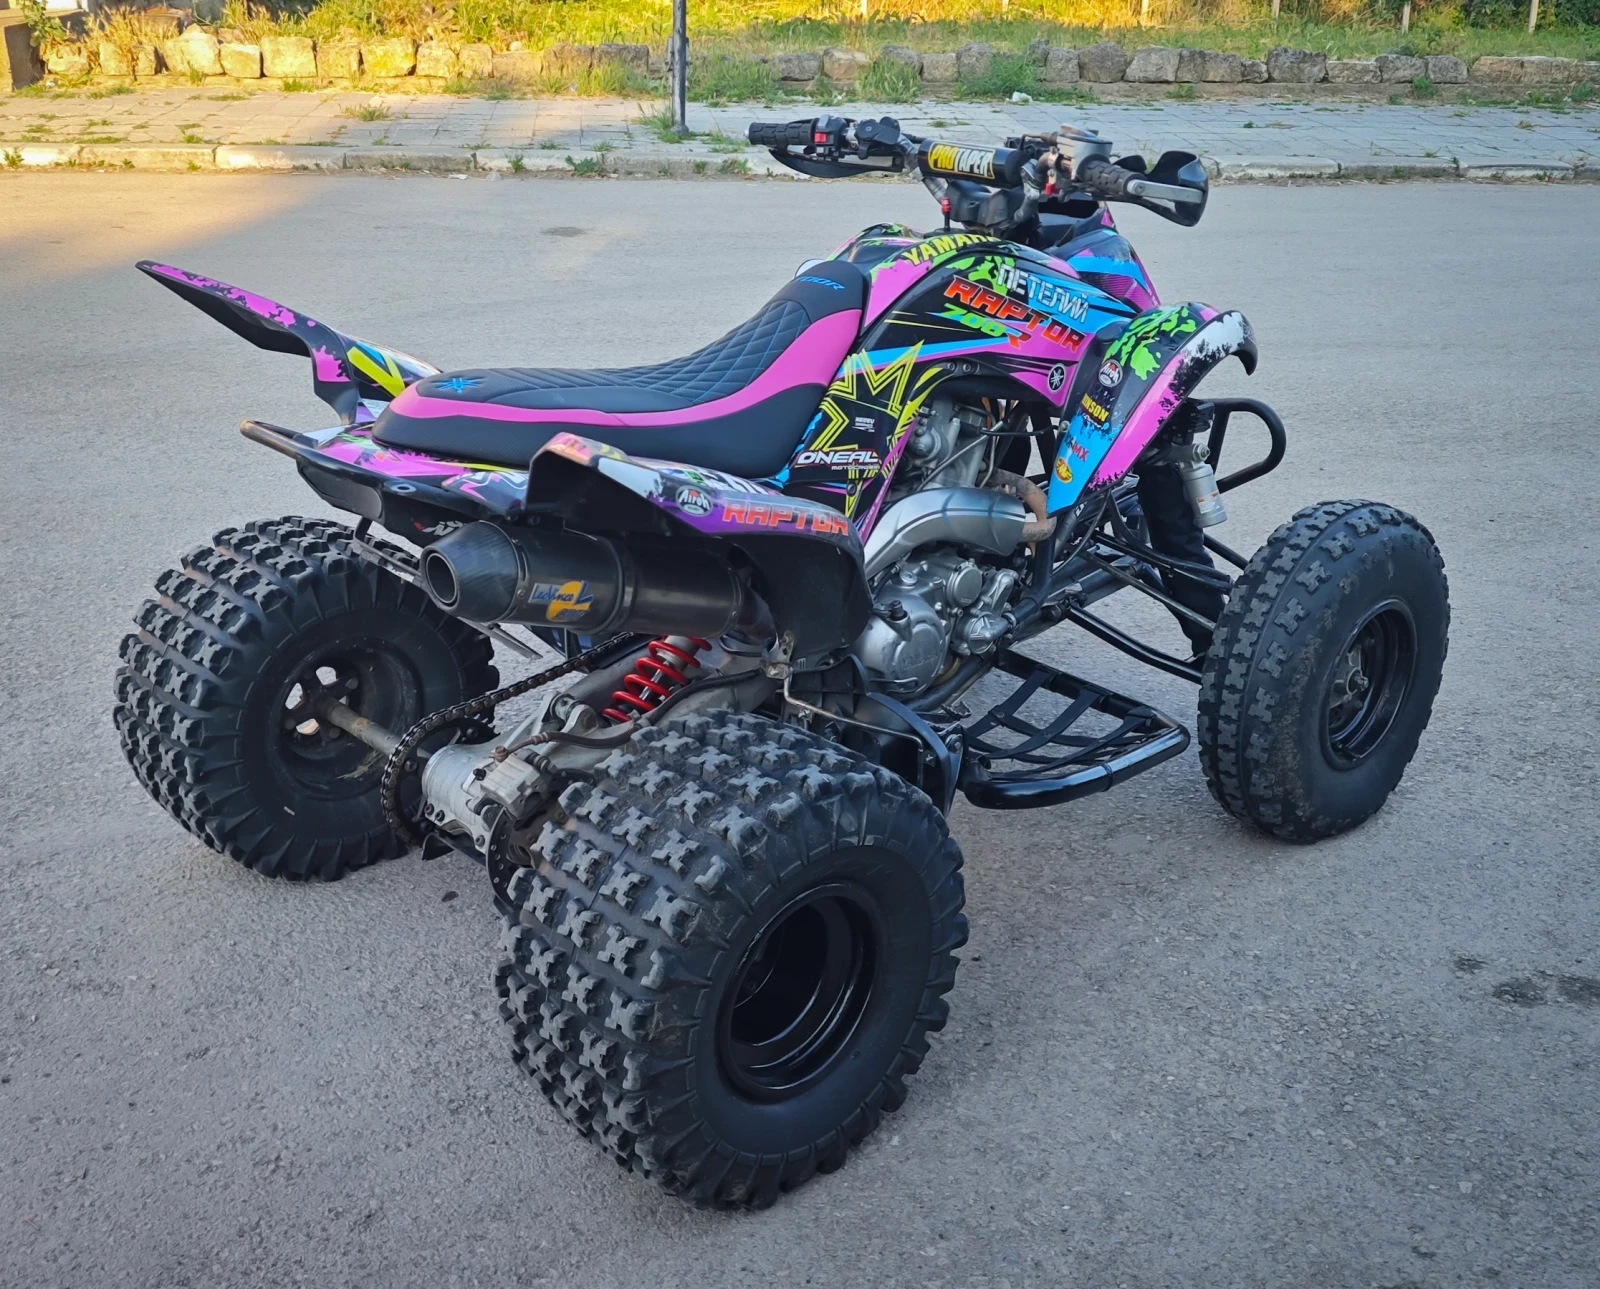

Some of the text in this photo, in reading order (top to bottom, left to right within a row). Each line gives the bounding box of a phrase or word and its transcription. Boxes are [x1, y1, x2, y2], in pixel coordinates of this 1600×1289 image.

[930, 145, 993, 177] PROTAPER
[943, 274, 1087, 354] RAPTOR
[722, 500, 849, 537] RAPTOR
